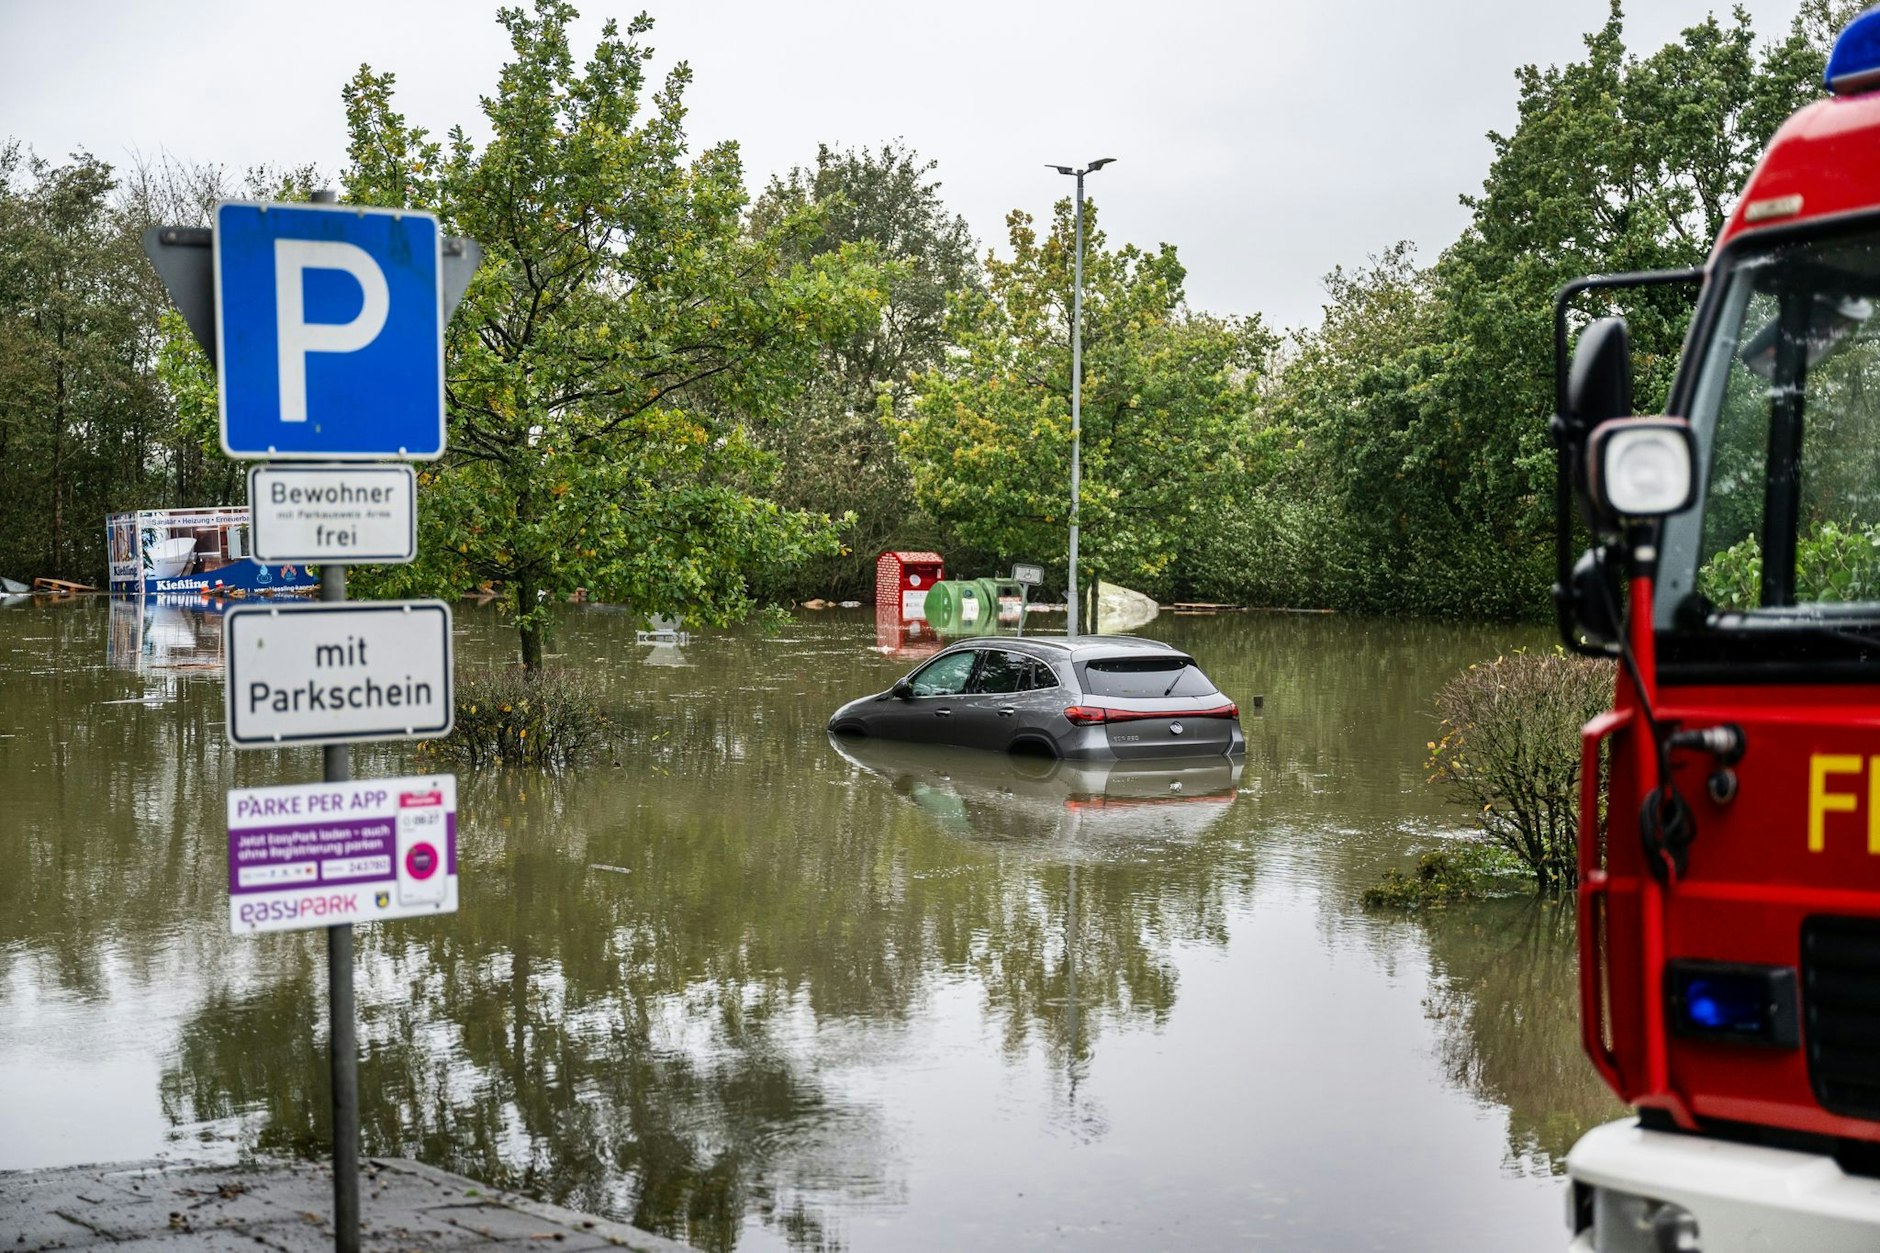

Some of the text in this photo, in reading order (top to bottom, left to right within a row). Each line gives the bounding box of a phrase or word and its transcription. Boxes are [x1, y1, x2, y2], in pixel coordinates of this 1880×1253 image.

[274, 238, 390, 422] P
[271, 482, 394, 504] Bewohner
[152, 515, 250, 526] Sanitär Heizung Erneuerba
[316, 525, 357, 546] frei
[113, 566, 137, 577] Kießling
[156, 579, 209, 592] Kießling
[316, 636, 367, 668] mit
[250, 676, 431, 714] Parkschein
[237, 795, 301, 818] PARKE
[308, 792, 343, 813] PER
[350, 790, 388, 809] APP
[238, 834, 266, 848] Jetzt
[268, 830, 317, 846] EasyPark
[319, 828, 352, 841] laden
[361, 825, 390, 838] auch
[238, 838, 383, 861] ohne Registrierung parken
